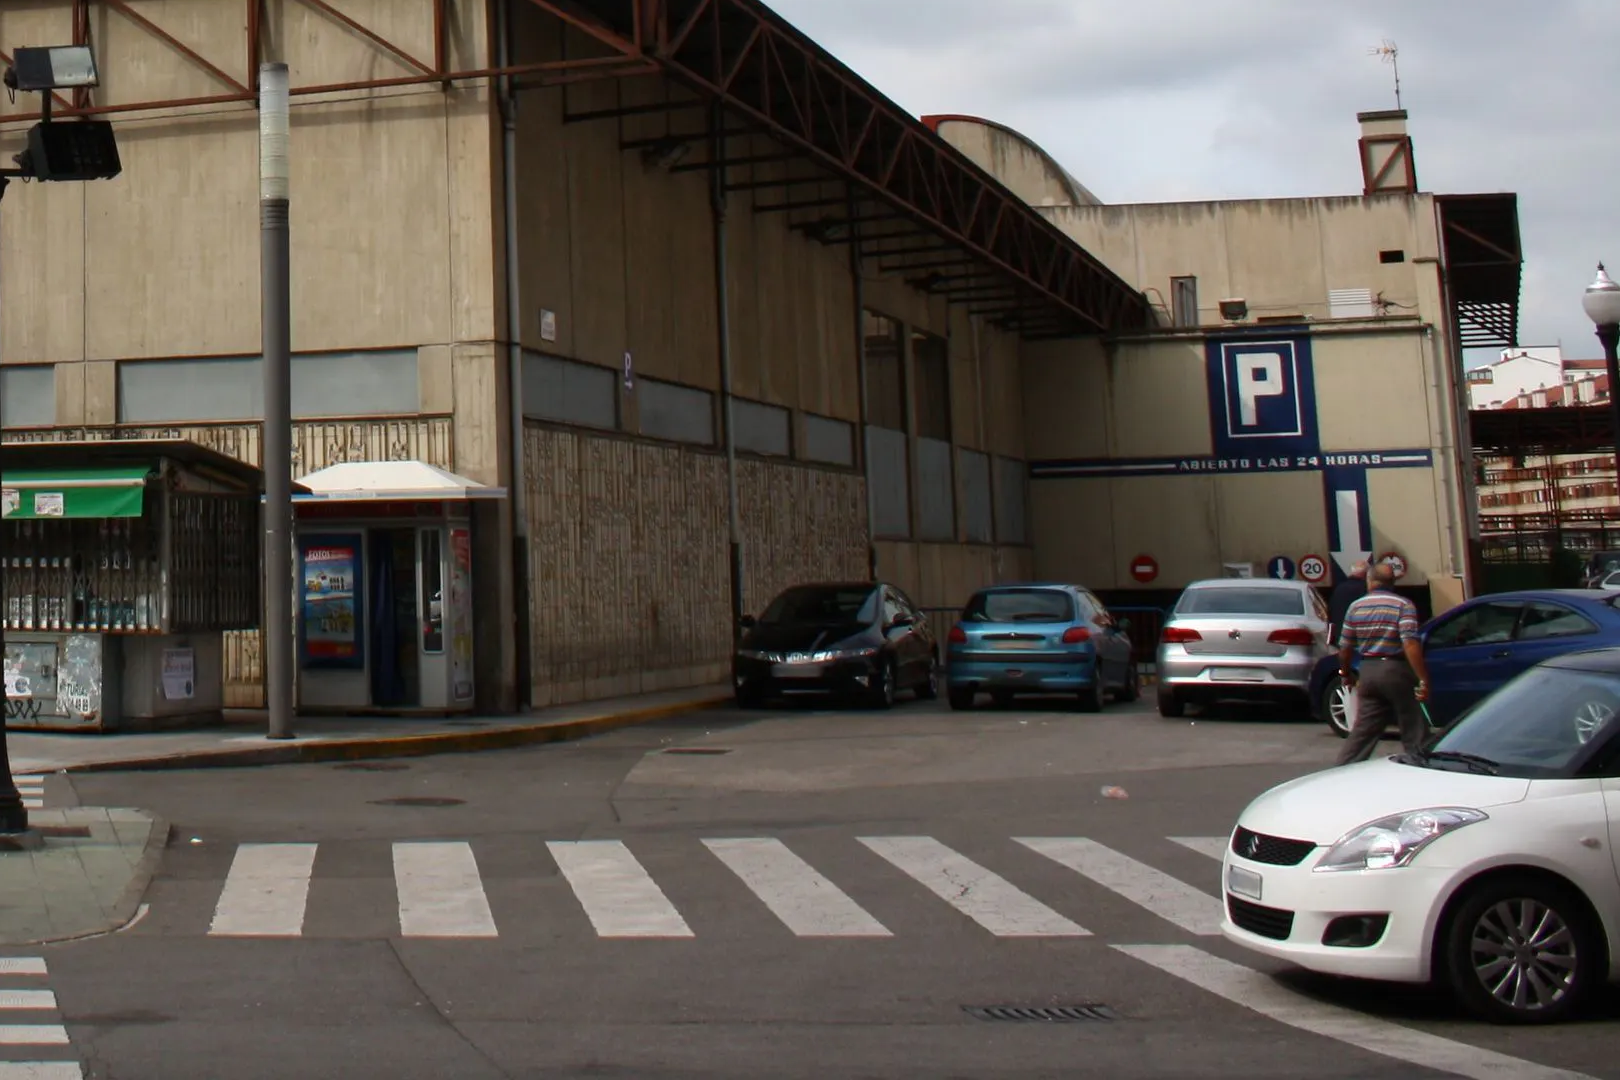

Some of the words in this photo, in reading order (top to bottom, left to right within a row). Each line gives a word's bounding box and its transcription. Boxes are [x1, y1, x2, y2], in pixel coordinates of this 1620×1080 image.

[624, 352, 632, 377] P
[1235, 352, 1283, 426] P
[1180, 458, 1250, 470] ABIERTO
[1257, 457, 1289, 468] LAS
[1297, 456, 1318, 467] 24
[1326, 454, 1381, 465] HORAS
[1304, 563, 1322, 574] 20
